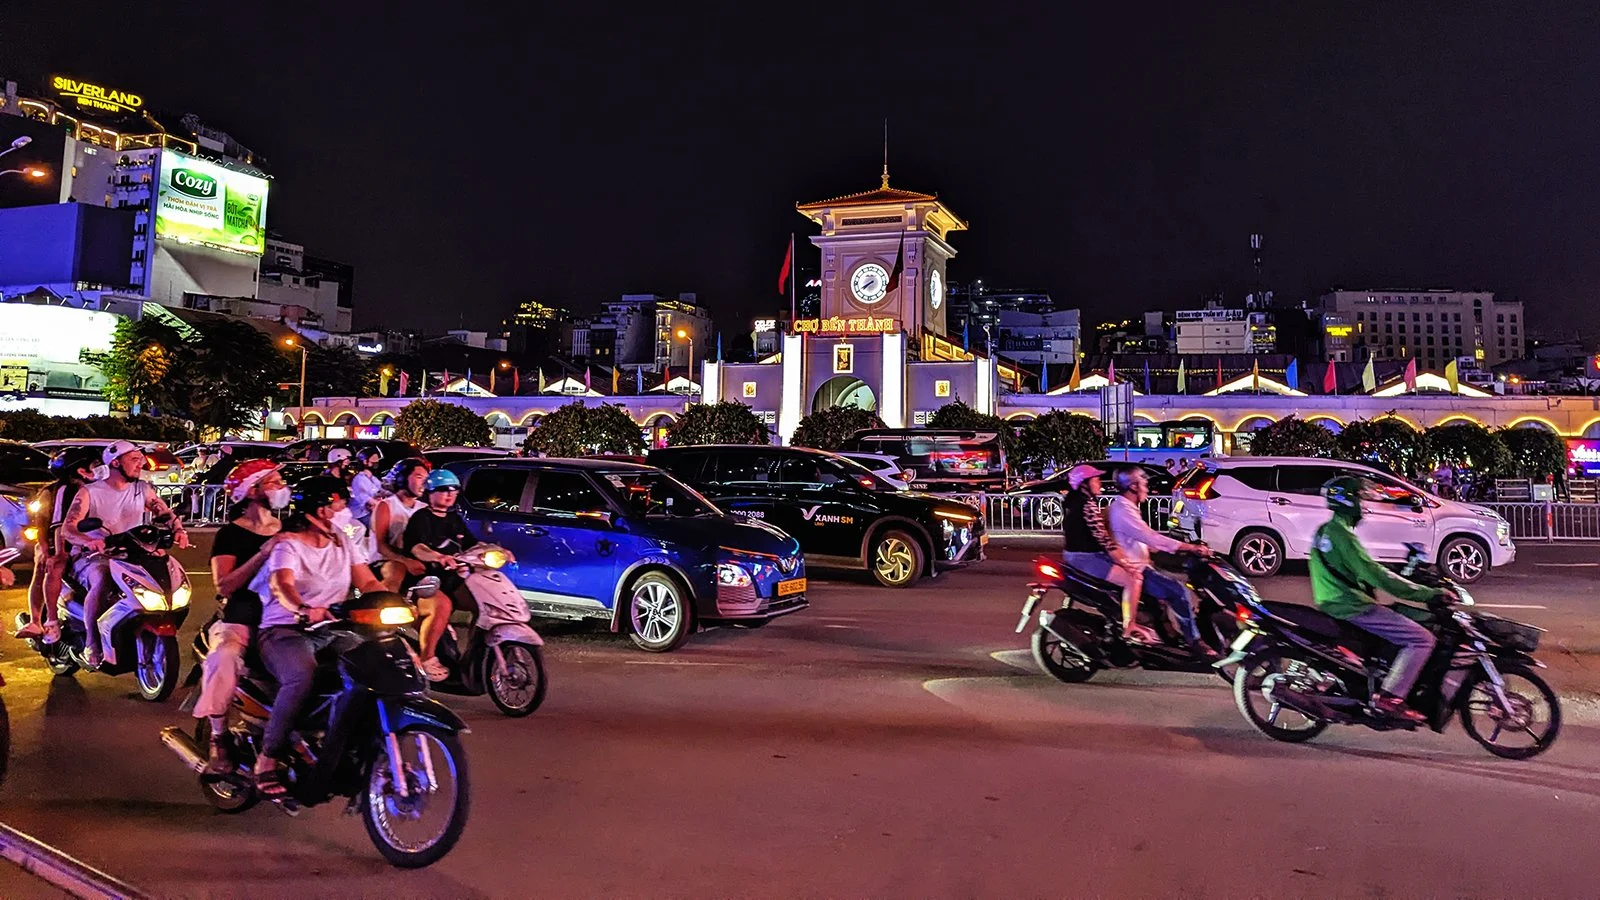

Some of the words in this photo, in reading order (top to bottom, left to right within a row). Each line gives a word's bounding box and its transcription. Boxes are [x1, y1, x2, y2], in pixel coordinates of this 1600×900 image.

[53, 76, 142, 107] SILVERLAND
[175, 171, 214, 196] Cozy
[227, 215, 249, 230] MATCHA
[794, 318, 819, 332] CHỢ
[822, 316, 845, 331] BẾN
[815, 515, 839, 523] XANH
[841, 516, 853, 524] SM
